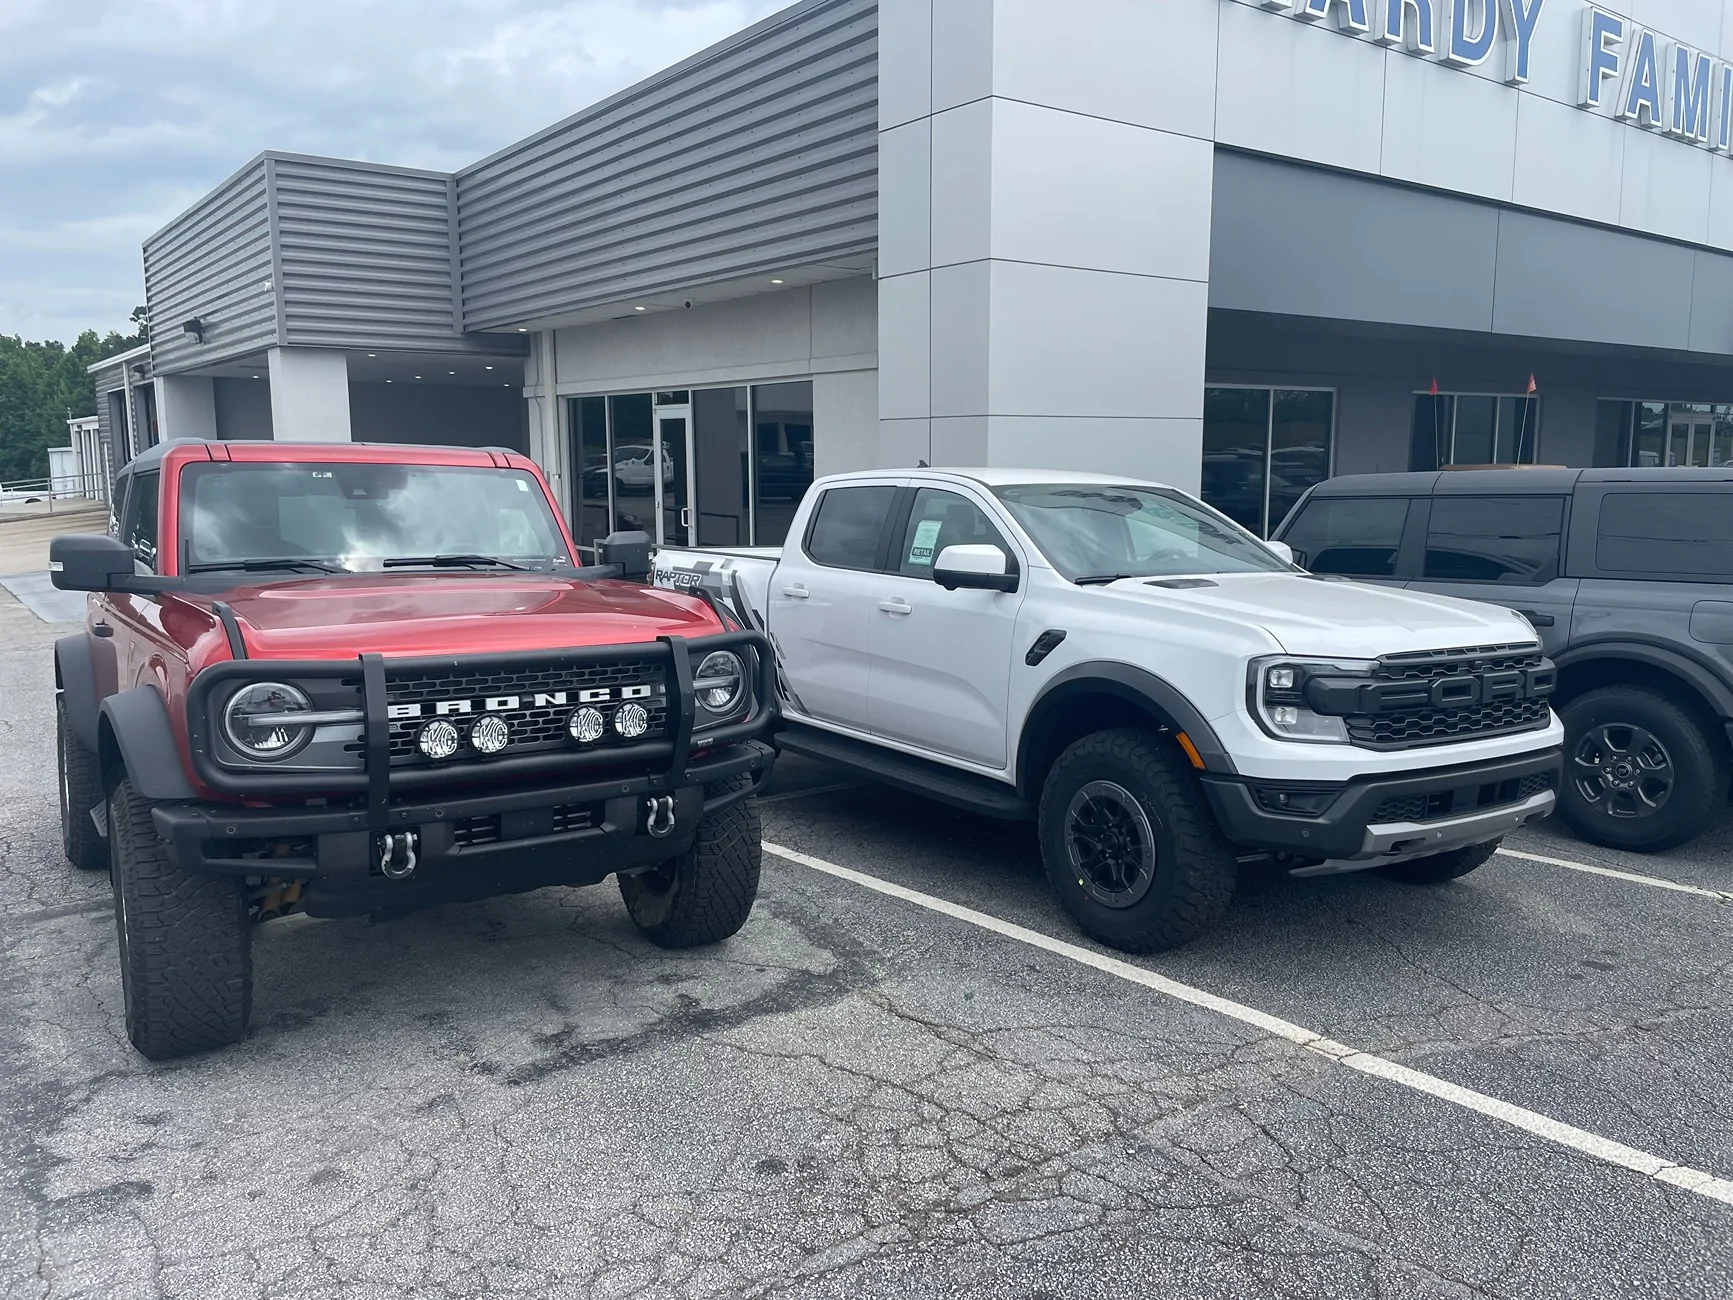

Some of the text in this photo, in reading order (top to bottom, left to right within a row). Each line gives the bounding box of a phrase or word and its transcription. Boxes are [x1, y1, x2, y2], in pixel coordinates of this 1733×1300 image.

[912, 548, 931, 556] RETAIL
[655, 569, 702, 587] RAPTOR
[387, 685, 651, 718] BRONCO
[1366, 666, 1557, 713] FORD
[479, 718, 508, 752] KC
[577, 709, 604, 739] KC
[622, 706, 648, 735] KC
[427, 724, 458, 757] KC
